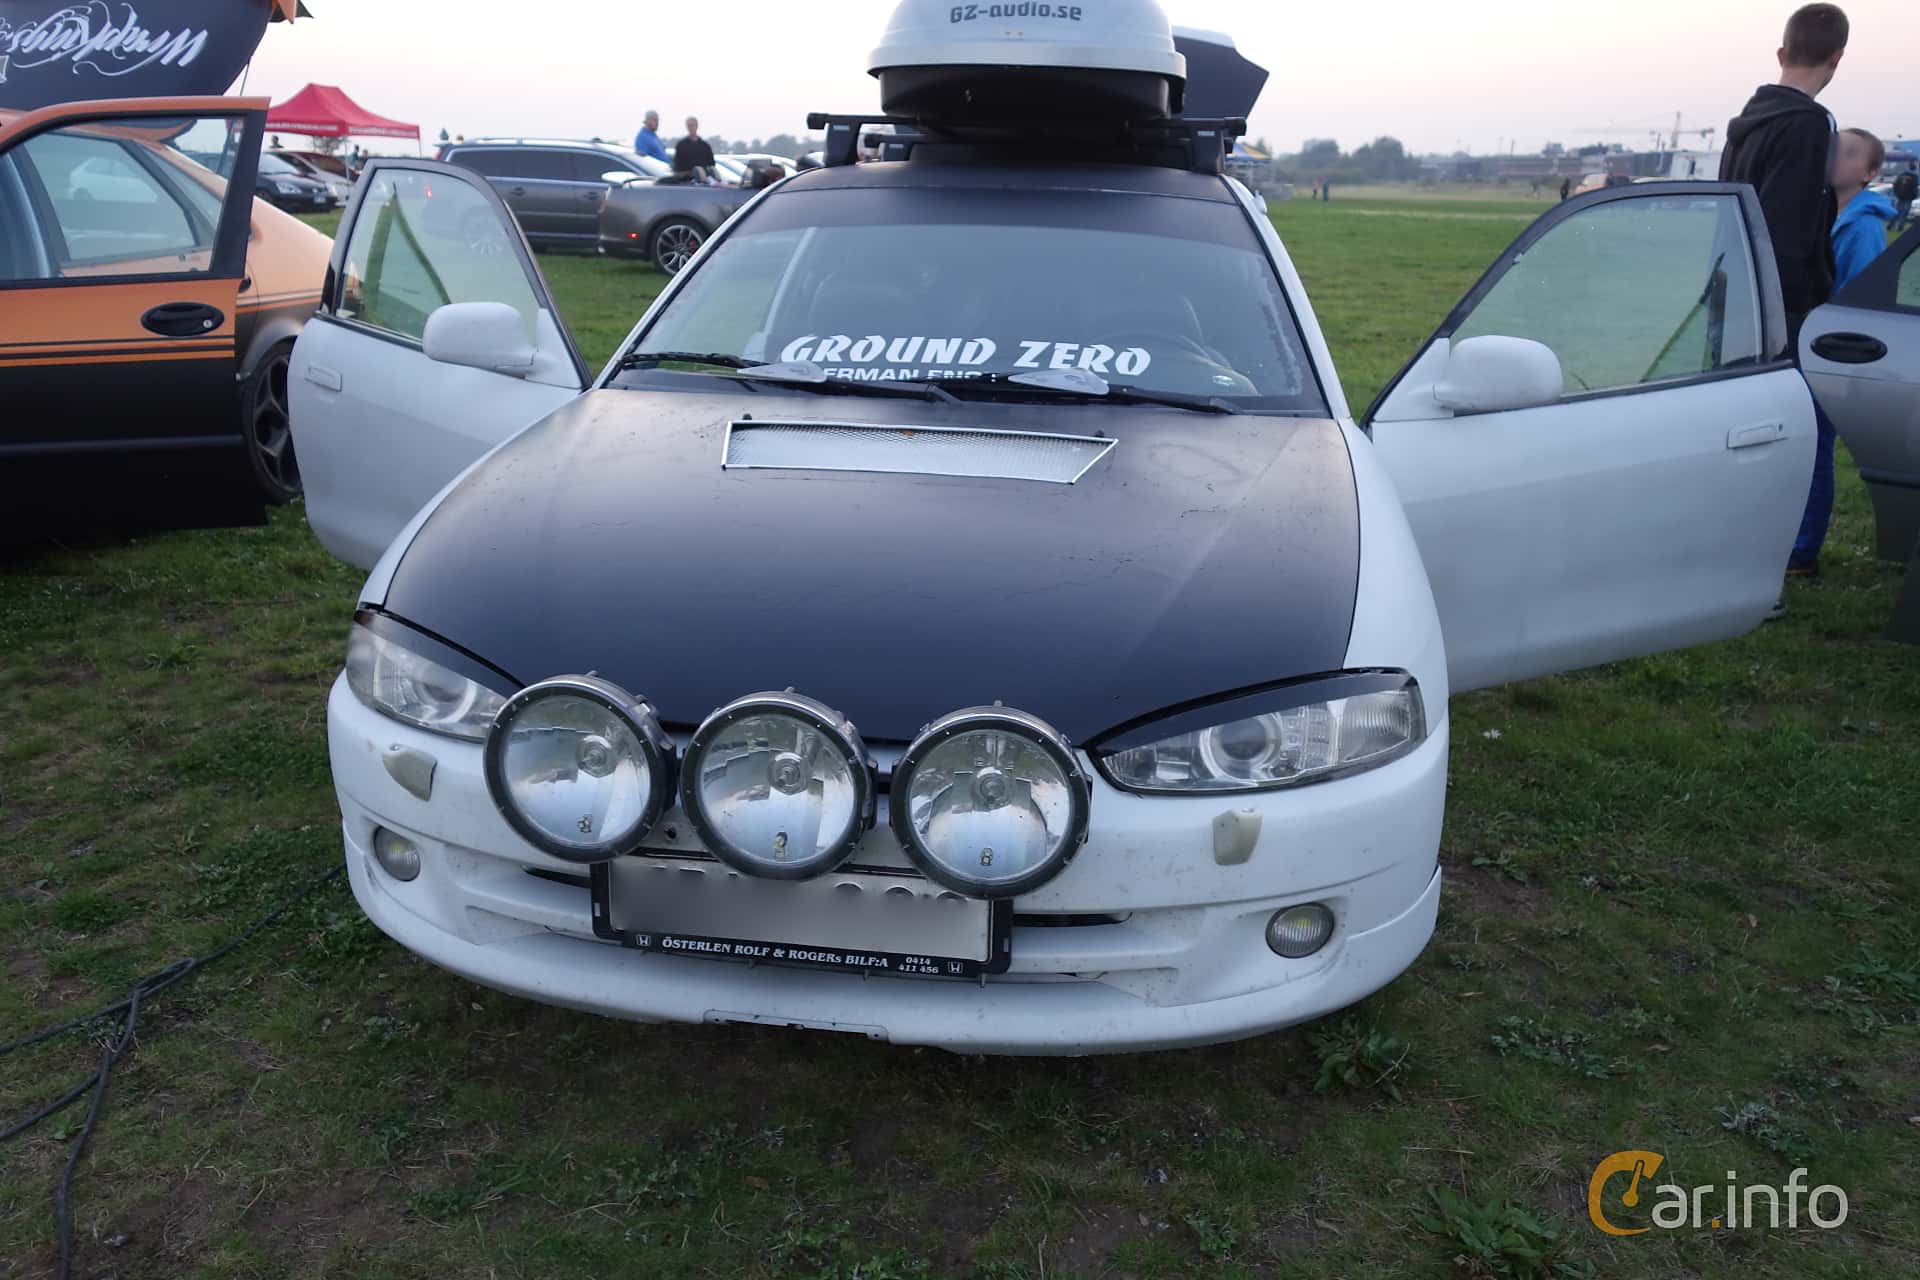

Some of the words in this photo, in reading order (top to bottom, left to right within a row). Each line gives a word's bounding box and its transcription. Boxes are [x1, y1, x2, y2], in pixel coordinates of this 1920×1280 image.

[950, 1, 1082, 23] GZ-audio.se
[780, 334, 997, 366] GROUND
[1013, 340, 1152, 376] ZERO
[823, 366, 919, 381] ERMAN
[662, 936, 731, 954] ÖSTERLEN
[735, 944, 770, 957] ROLF
[773, 949, 785, 958] &
[905, 956, 931, 966] 0414
